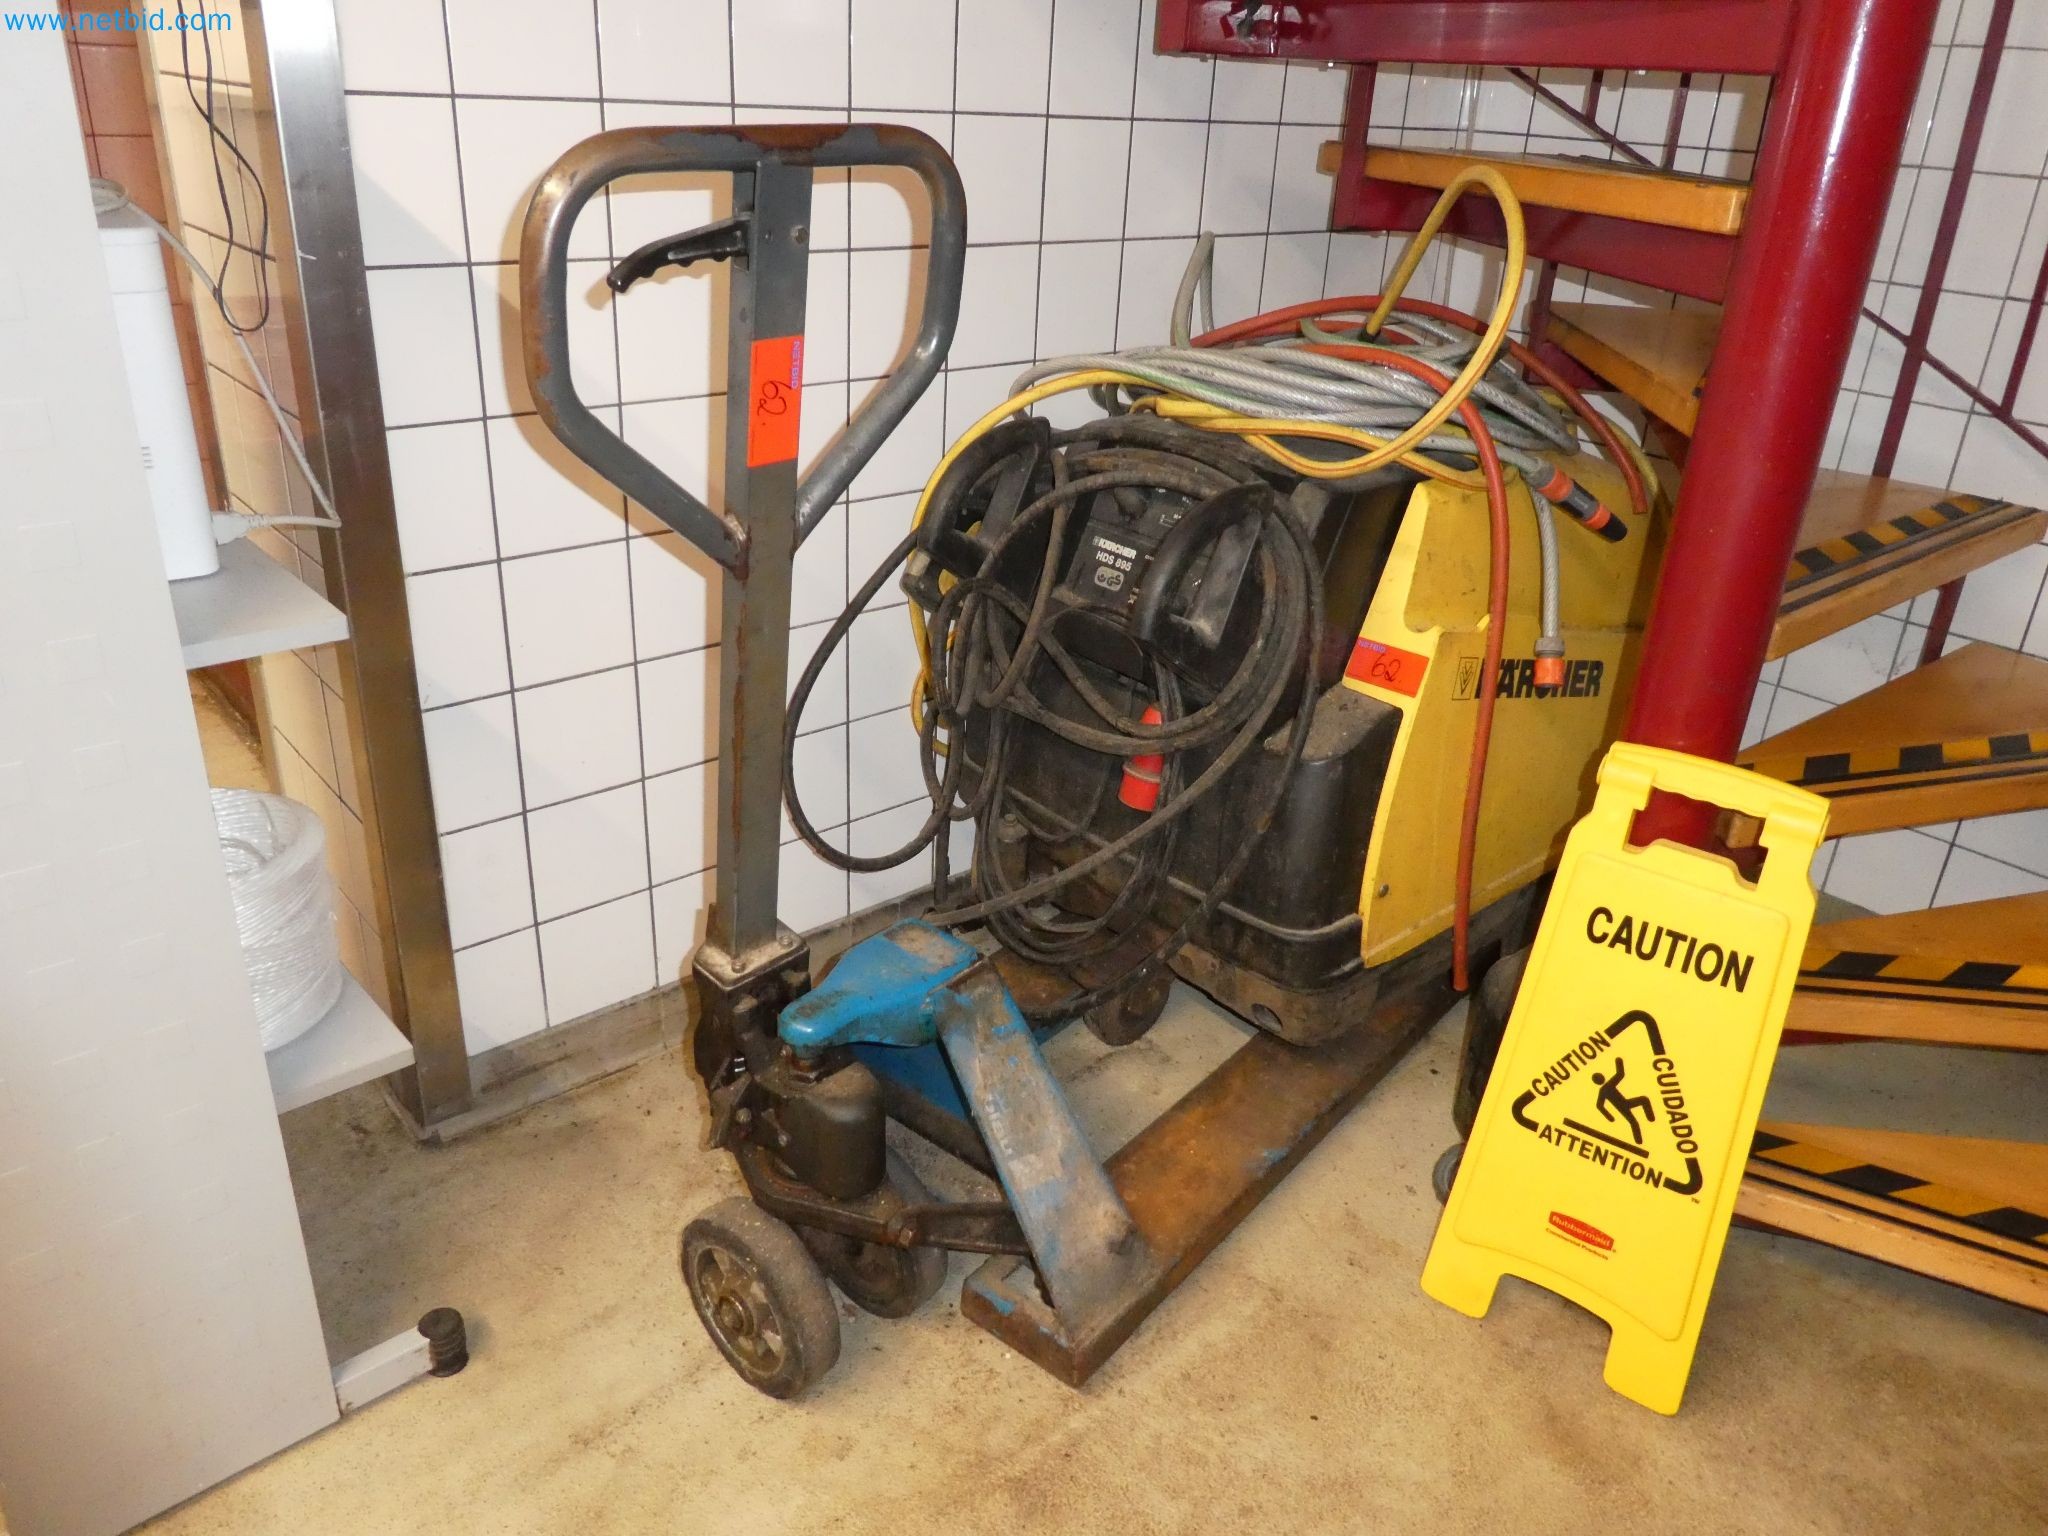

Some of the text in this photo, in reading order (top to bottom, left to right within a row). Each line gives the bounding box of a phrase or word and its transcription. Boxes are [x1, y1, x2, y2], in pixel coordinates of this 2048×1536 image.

[1095, 550, 1133, 572] HDS 895
[1586, 906, 1755, 993] CAUTION
[1531, 1030, 1611, 1097] CAUTION
[1652, 1057, 1699, 1154] CUIDADO
[1538, 1123, 1663, 1189] ATTENTION
